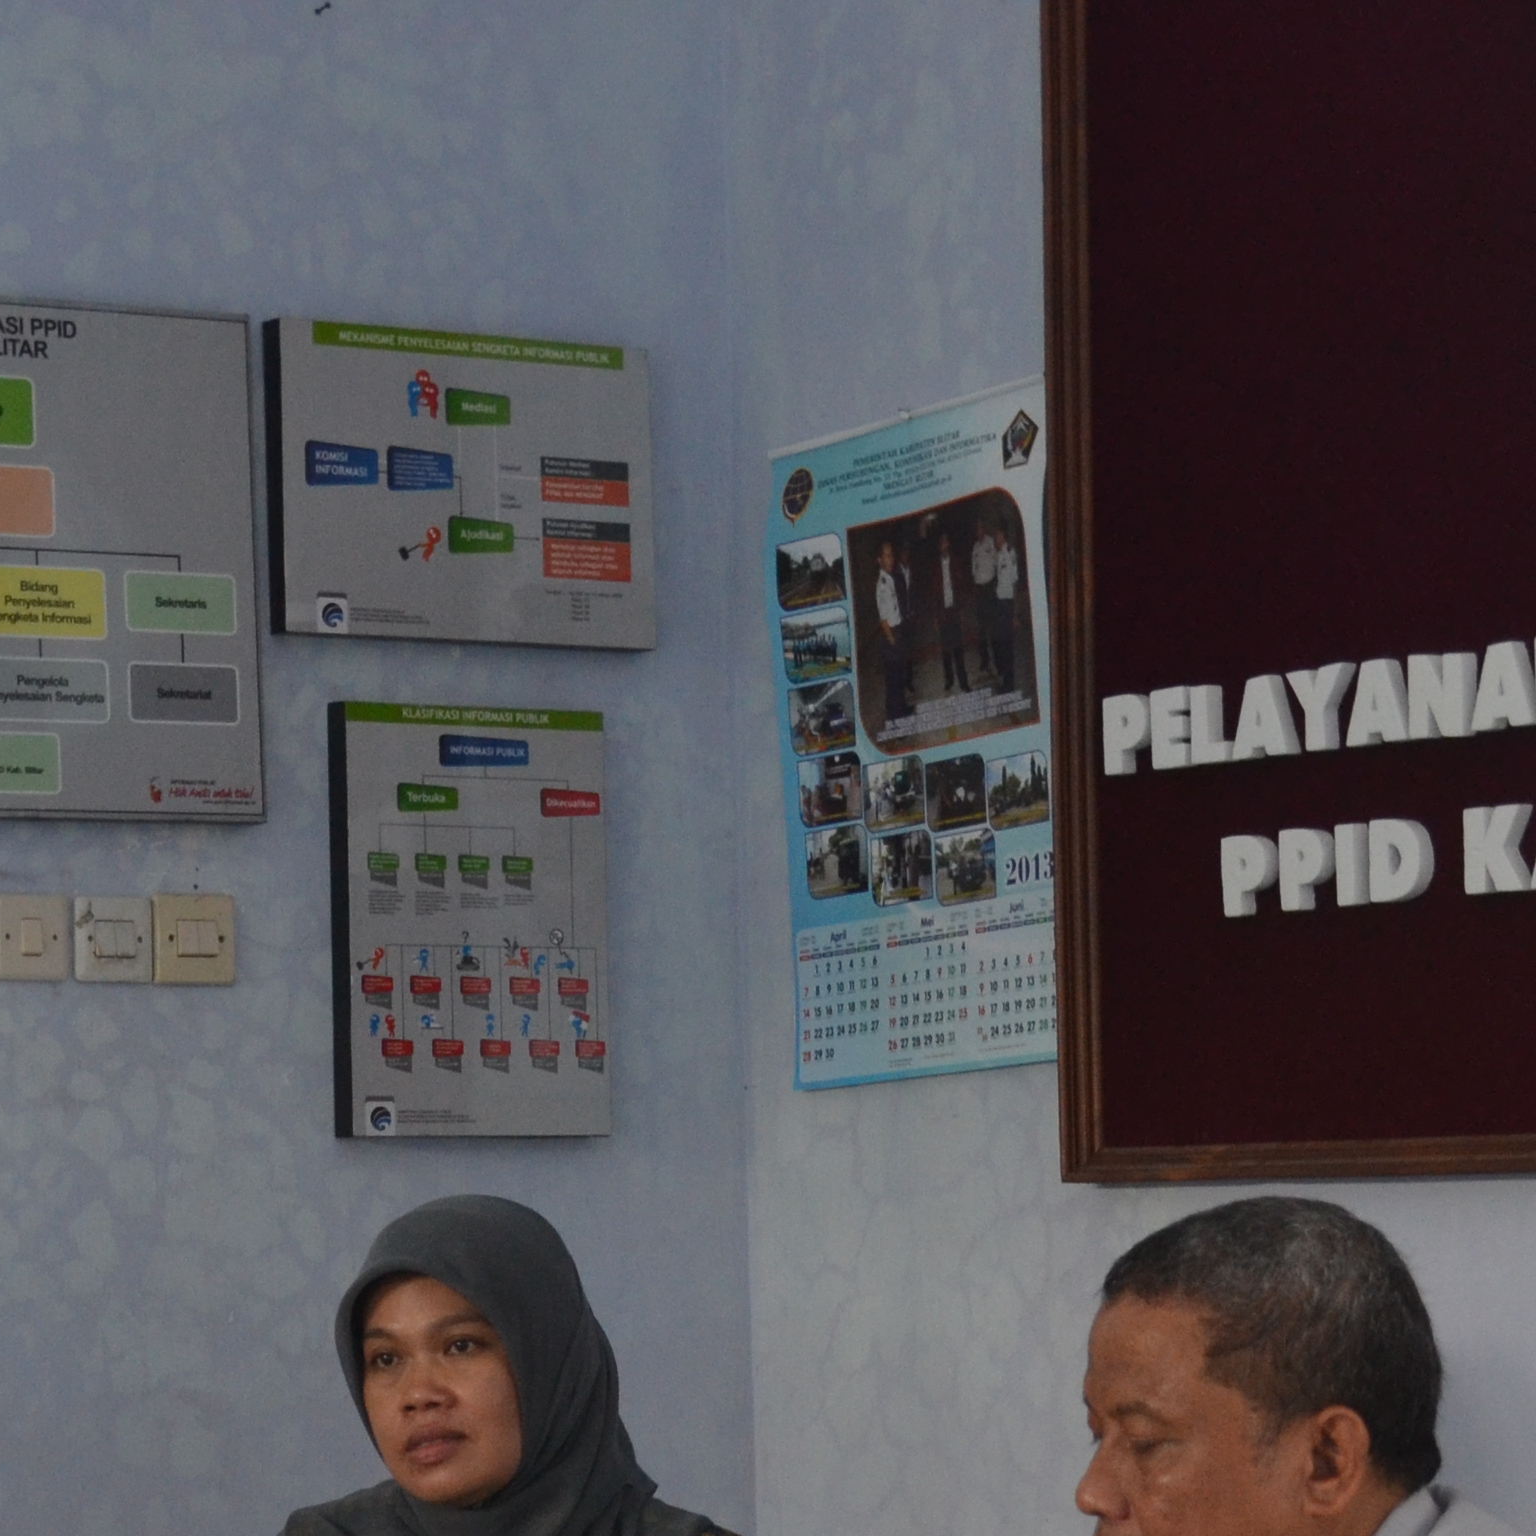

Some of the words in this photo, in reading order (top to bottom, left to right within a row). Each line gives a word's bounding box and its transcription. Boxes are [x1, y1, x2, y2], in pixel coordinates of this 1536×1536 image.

[30, 317, 77, 339] PPID
[338, 331, 395, 346] MEKANISME
[398, 336, 469, 352] PENYELESAIAN
[472, 341, 520, 357] SENGKETA
[522, 346, 573, 361] INFORMASI
[575, 349, 609, 364] PUBLIK
[461, 401, 497, 414] Mediasi
[315, 450, 348, 462] KOMISI
[315, 465, 368, 478] INFORMASI
[460, 529, 504, 541] Ajudikasi
[19, 580, 58, 596] Bidang
[4, 595, 75, 611] Penyelesaian
[155, 596, 207, 610] Sekretaris
[41, 611, 92, 625] Informasi
[16, 674, 69, 690] Pengelola
[55, 691, 105, 706] Sengketa
[156, 686, 212, 700] Sekretariat
[402, 707, 460, 720] KLASIFIKASI
[462, 710, 513, 723] INFORMASI
[516, 712, 549, 725] PUBLIK
[449, 744, 495, 757] INFORMASI
[496, 746, 526, 758] PUBLIK
[407, 791, 446, 803] Terbuka
[546, 797, 597, 809] Dikecualikan
[1005, 851, 1054, 886] 2013
[1220, 819, 1435, 918] PPID
